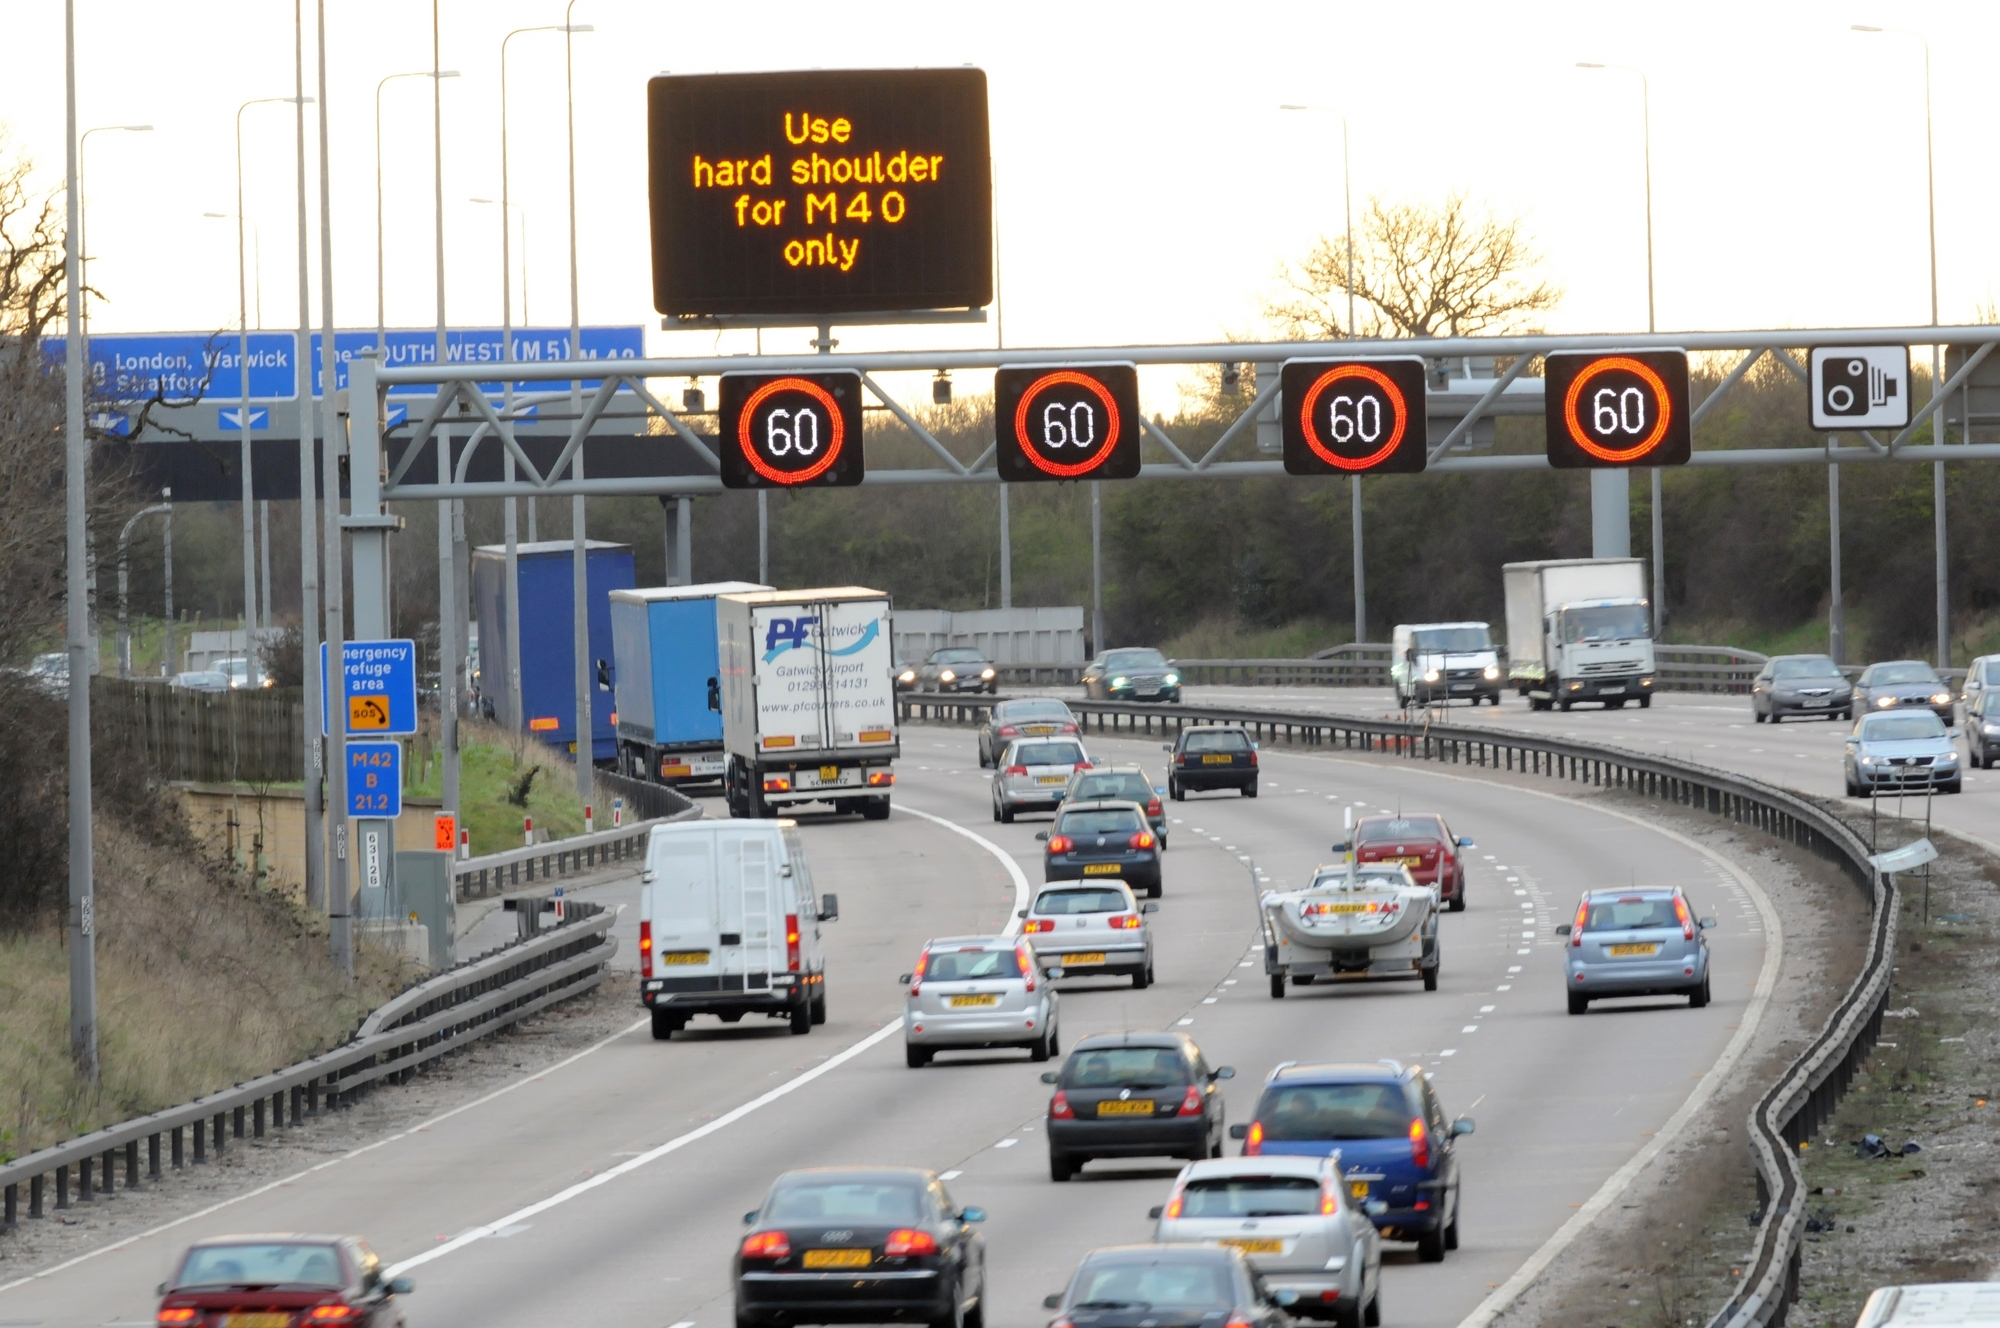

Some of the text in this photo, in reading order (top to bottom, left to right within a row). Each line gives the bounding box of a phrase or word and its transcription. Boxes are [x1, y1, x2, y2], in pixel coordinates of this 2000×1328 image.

[785, 112, 851, 144] Use
[694, 151, 943, 187] hard shoulder
[735, 194, 786, 226] for
[784, 233, 859, 271] only
[203, 349, 288, 369] Warwick
[116, 373, 211, 393] Stratford
[1330, 395, 1380, 443] 60
[1594, 387, 1645, 435] 60
[768, 408, 818, 456] 60
[1044, 402, 1094, 448] 60
[766, 616, 819, 651] PF
[345, 662, 391, 677] refuge
[776, 662, 864, 677] Gatwick Airport
[352, 680, 384, 691] area
[788, 680, 824, 693] 01293
[353, 709, 376, 719] SOS
[761, 697, 886, 713] www.pfcouriers.co.uk
[352, 752, 391, 768] M42
[366, 773, 377, 788] B
[355, 795, 388, 810] 21.2
